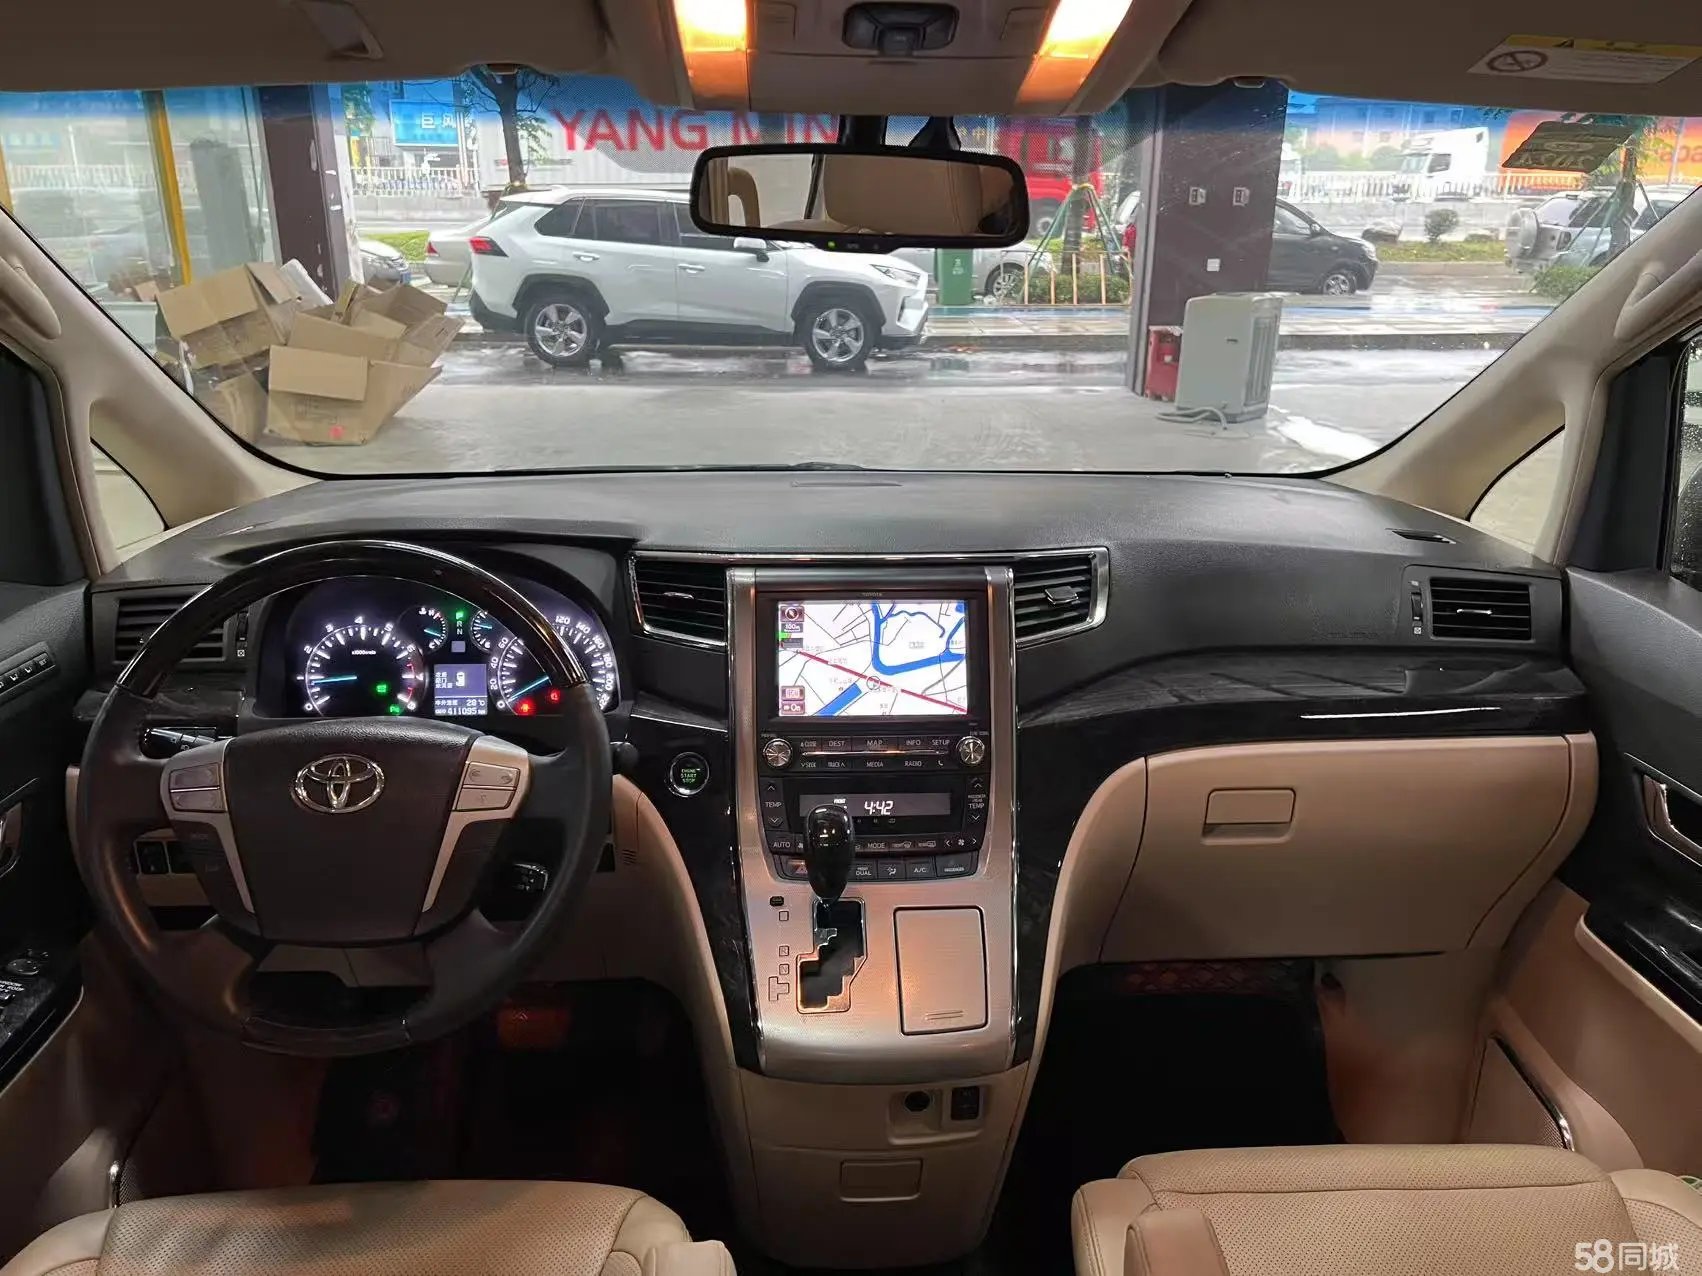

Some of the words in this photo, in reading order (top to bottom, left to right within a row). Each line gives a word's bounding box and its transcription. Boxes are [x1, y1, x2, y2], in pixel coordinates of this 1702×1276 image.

[554, 109, 709, 151] YANG
[556, 615, 571, 625] 120
[575, 622, 591, 635] 140
[498, 637, 510, 649] 60
[592, 634, 606, 650] 160
[303, 644, 313, 654] 2
[490, 656, 499, 669] 40
[602, 653, 614, 669] 180
[489, 678, 498, 691] 20
[604, 673, 615, 691] 200
[304, 702, 314, 712] 0
[466, 699, 477, 707] 28
[496, 700, 506, 709] 0
[864, 801, 894, 815] 4:42
